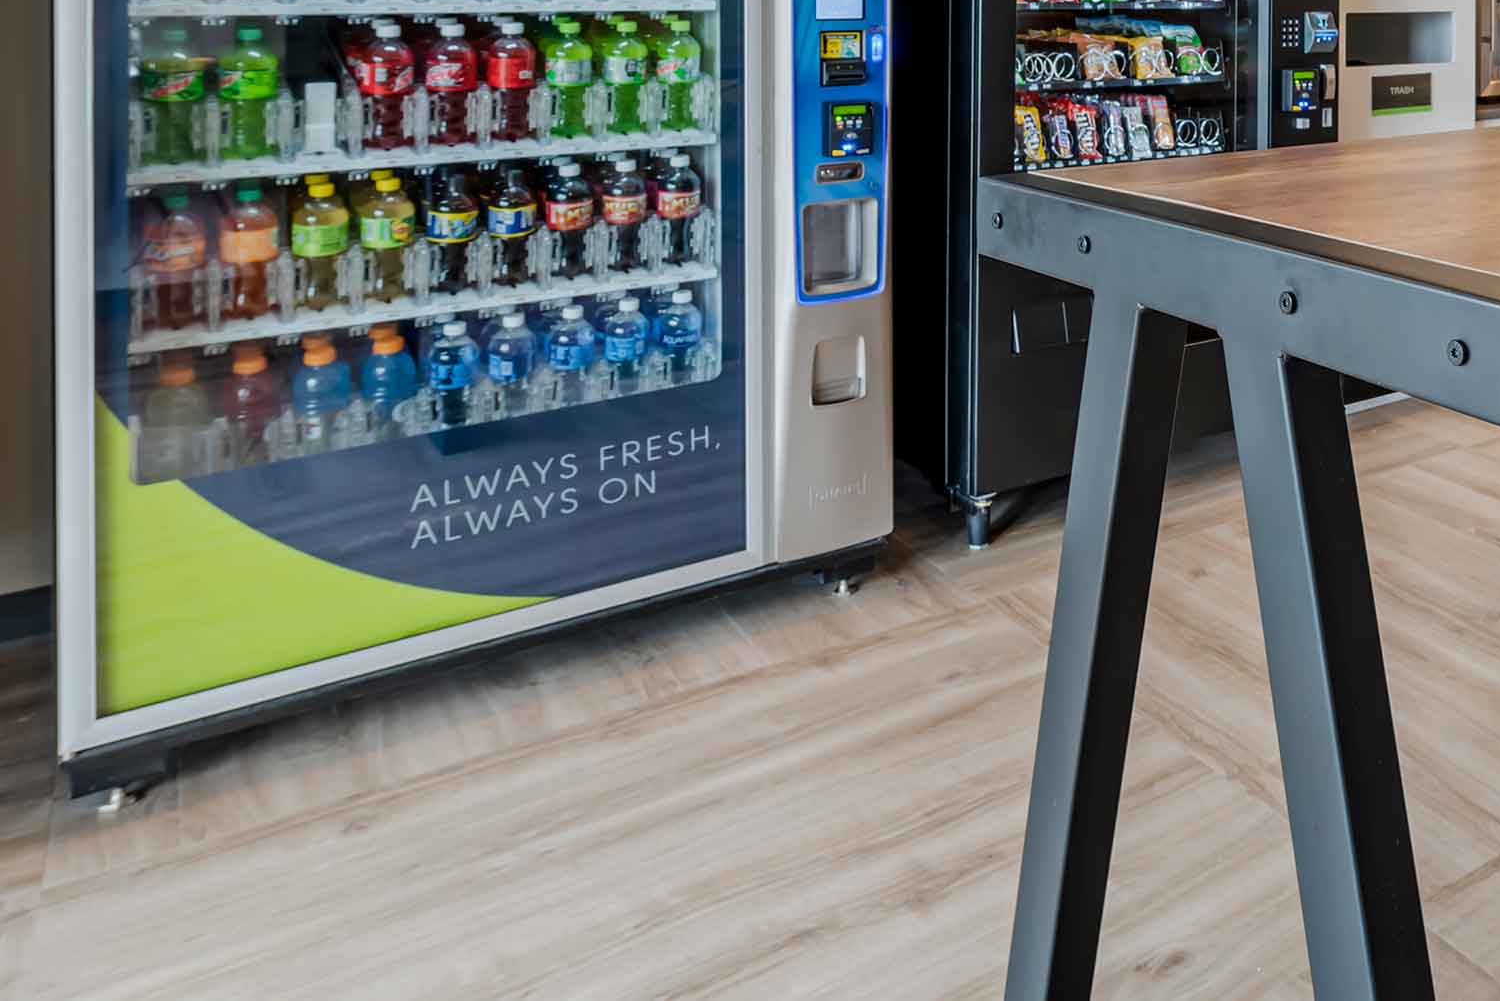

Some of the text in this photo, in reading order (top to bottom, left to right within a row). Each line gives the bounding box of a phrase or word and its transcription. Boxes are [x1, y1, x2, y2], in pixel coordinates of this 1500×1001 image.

[1389, 85, 1415, 95] TRASH
[410, 425, 721, 513] ALWAYS FRESH,
[411, 469, 657, 549] ALWAYS ON
